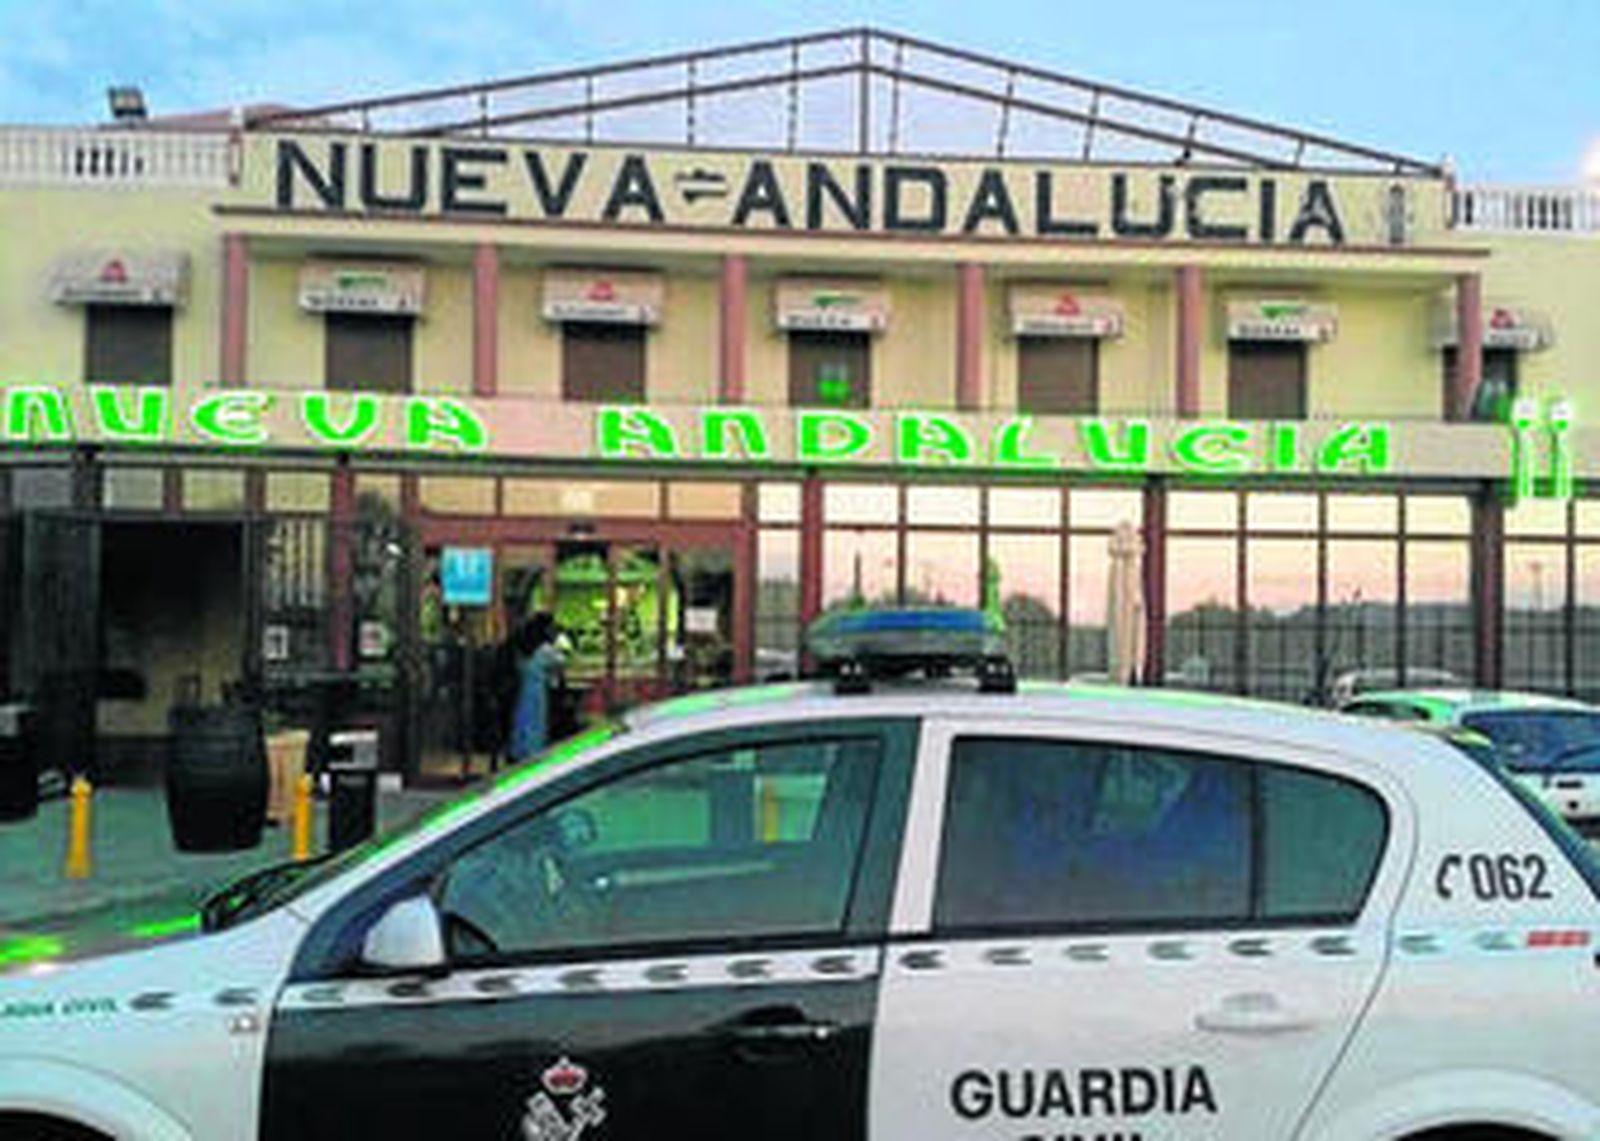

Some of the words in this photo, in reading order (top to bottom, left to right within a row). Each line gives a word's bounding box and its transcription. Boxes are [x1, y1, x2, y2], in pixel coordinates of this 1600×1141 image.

[275, 138, 667, 222] NUEVA
[730, 159, 1344, 243] ANDALUCIA
[5, 386, 487, 449] NUEVA
[1468, 853, 1554, 901] 062
[950, 1064, 1219, 1121] GUARDIA
